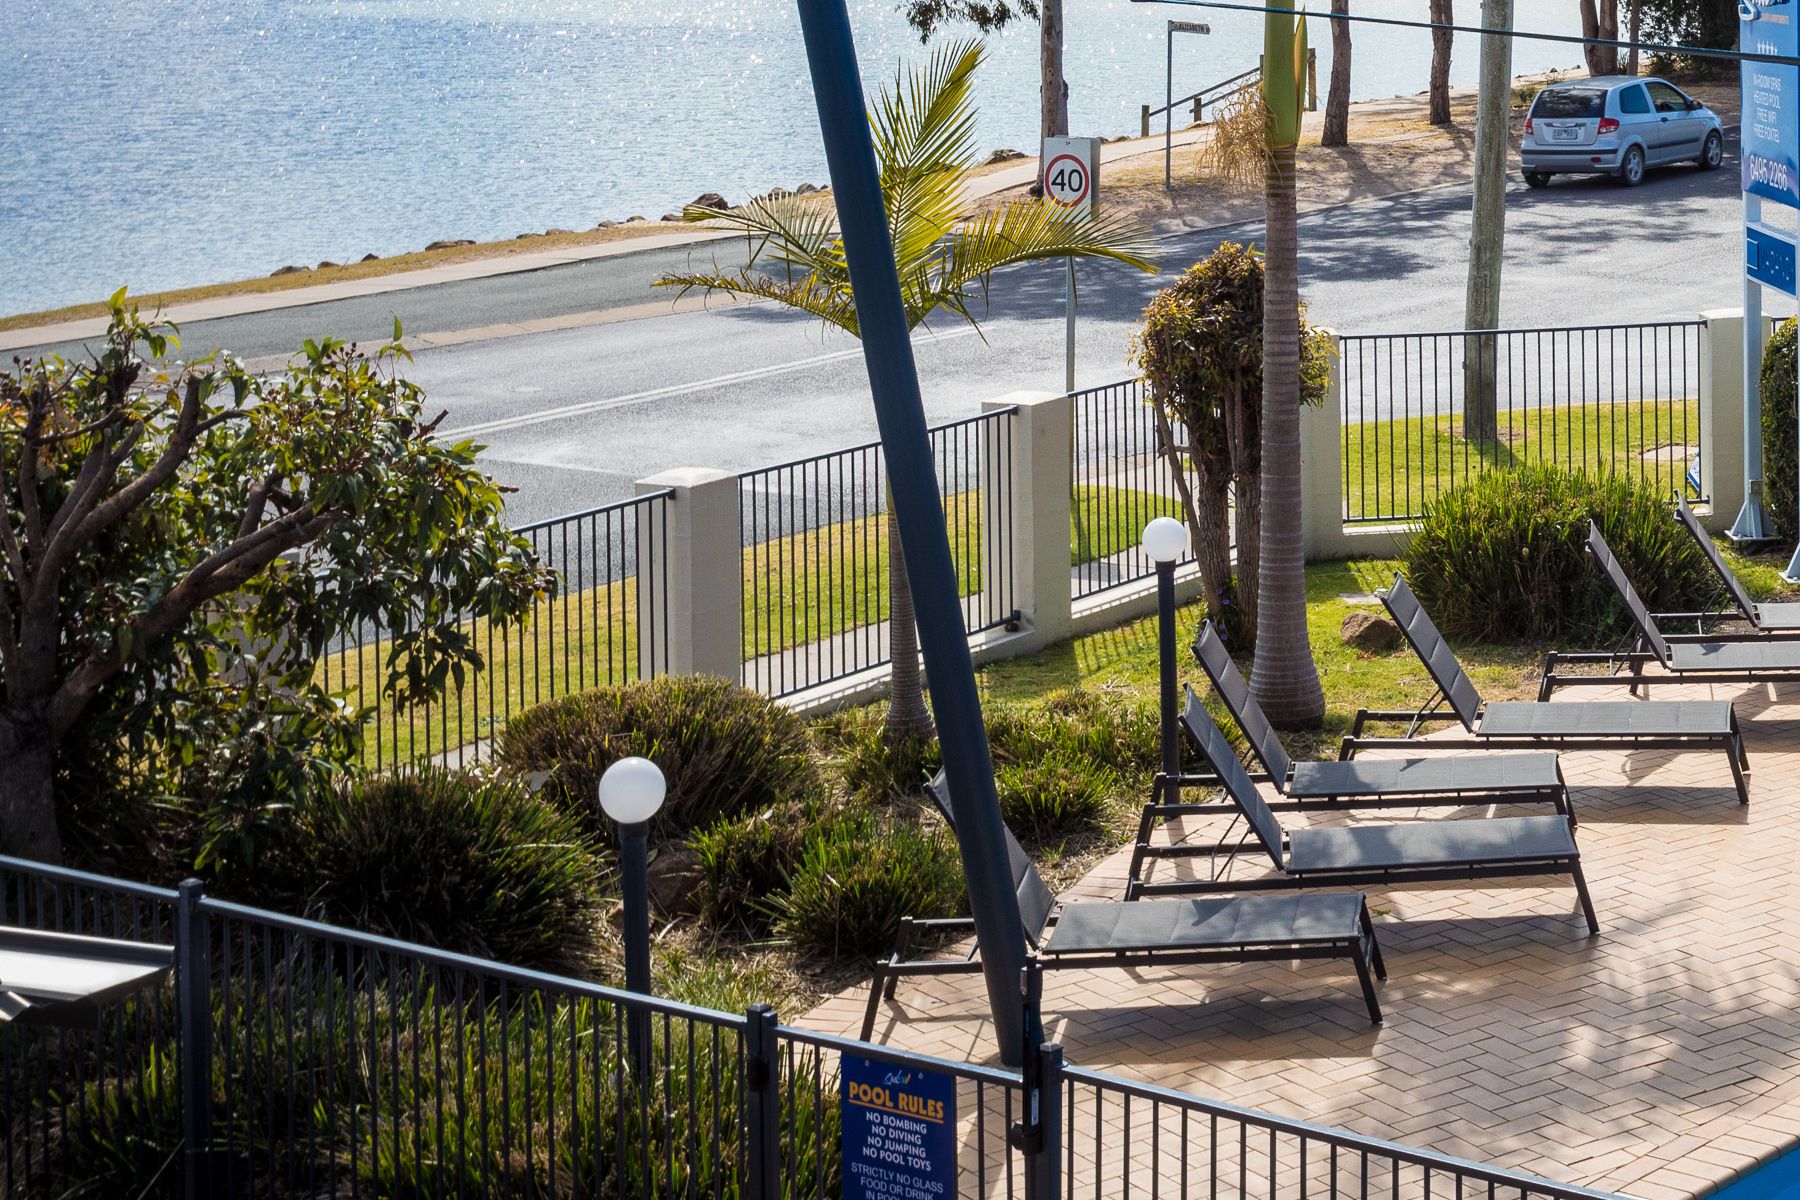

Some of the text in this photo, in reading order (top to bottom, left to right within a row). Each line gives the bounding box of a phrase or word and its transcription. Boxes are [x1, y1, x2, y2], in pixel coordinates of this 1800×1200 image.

[1051, 168, 1083, 193] 40
[1750, 154, 1787, 191] 6495 2266
[849, 1081, 944, 1119] POOL RULES
[866, 1111, 927, 1134] NO BOMBING
[871, 1124, 922, 1145] NO DIVING
[862, 1146, 932, 1172] NO POOL TOYS
[867, 1135, 926, 1158] NO JUMPING
[851, 1162, 944, 1193] STRICTLY NO GLASS
[861, 1176, 934, 1200] FOOD OR DRINK
